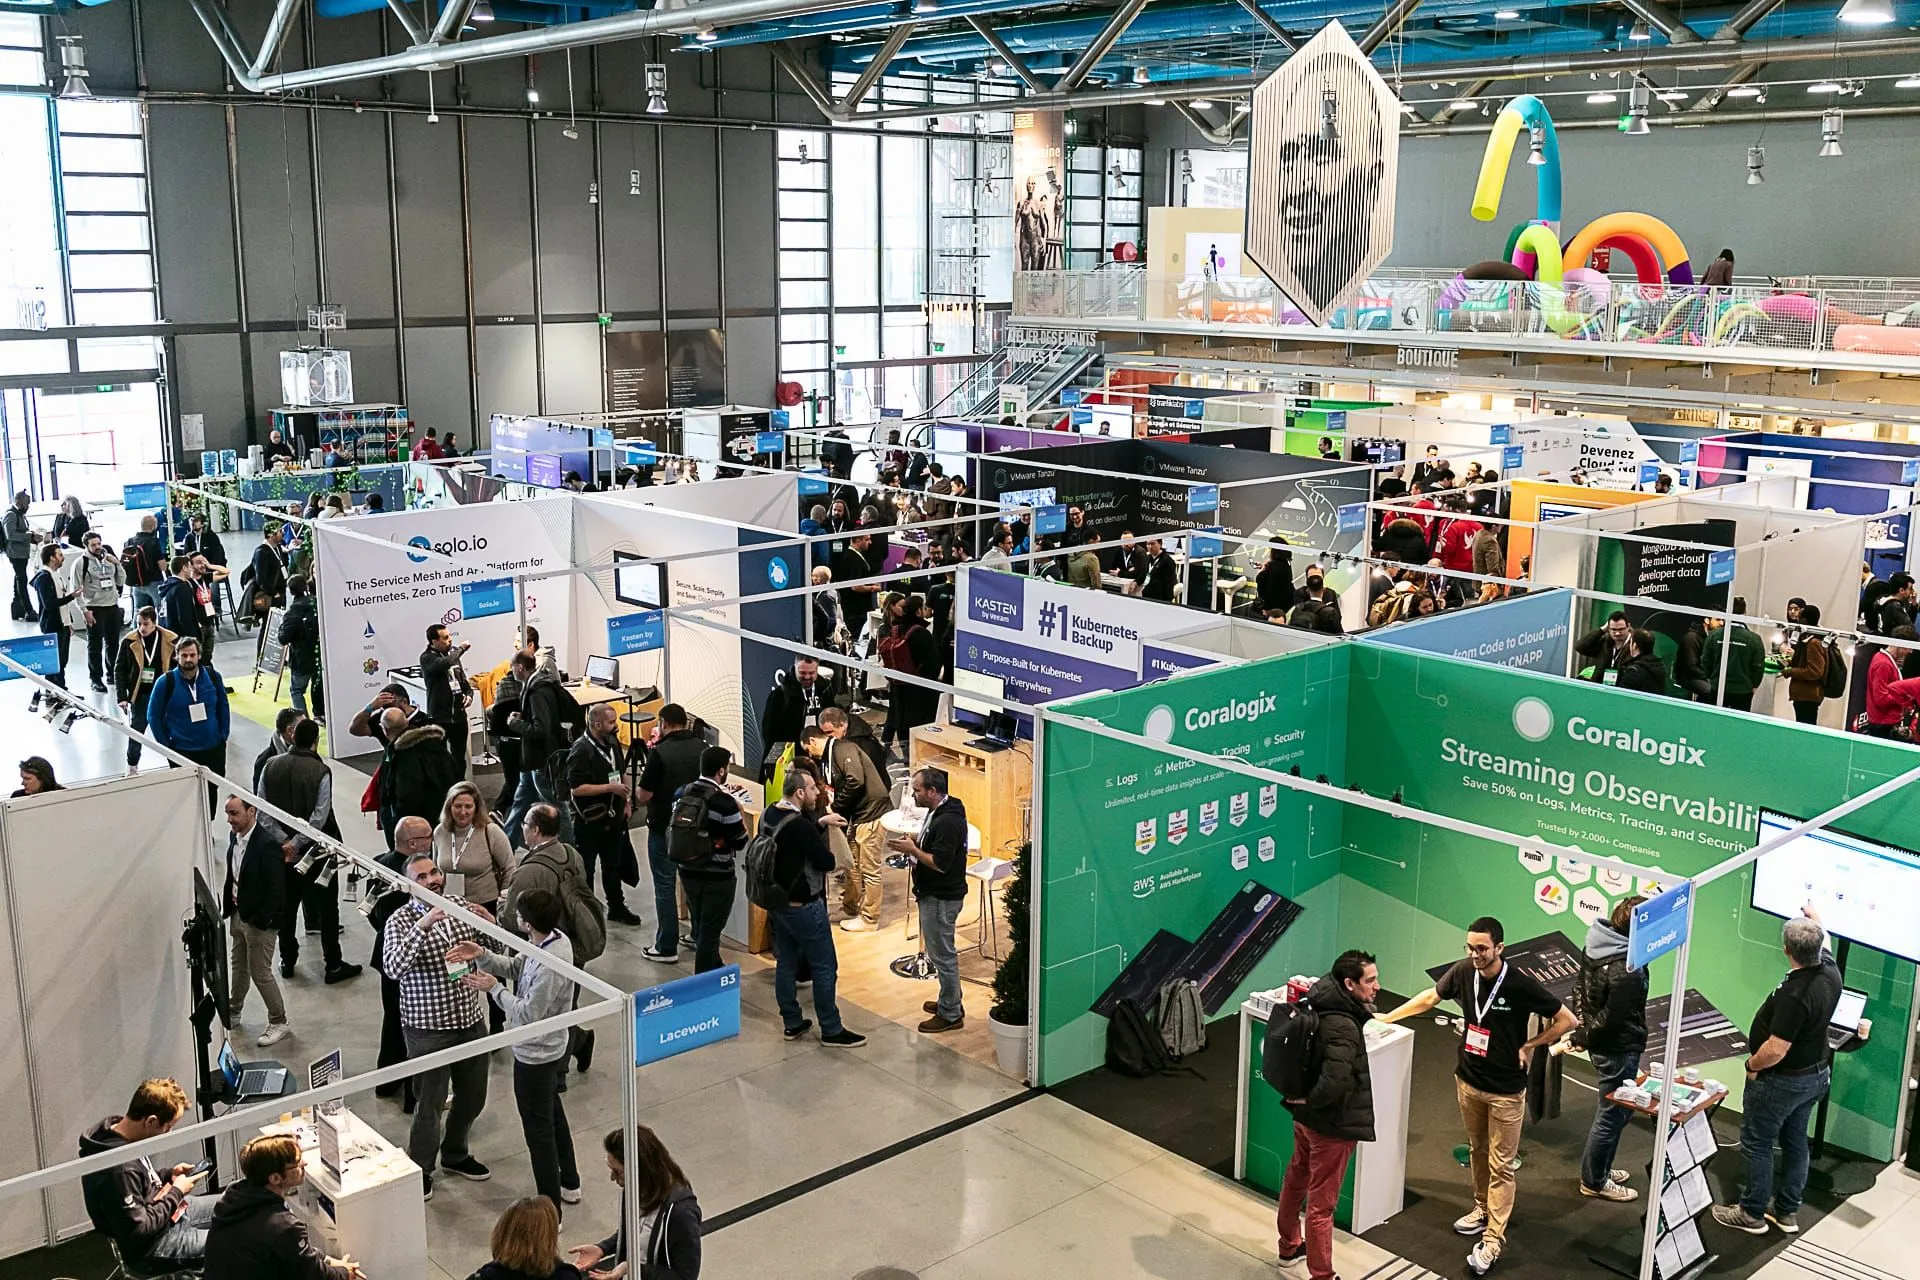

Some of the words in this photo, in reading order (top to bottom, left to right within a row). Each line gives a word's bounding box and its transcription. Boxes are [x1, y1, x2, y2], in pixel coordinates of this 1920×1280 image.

[1007, 327, 1039, 344] ATELIER
[1040, 331, 1057, 346] DES
[1058, 331, 1096, 347] ENFANTS
[1397, 348, 1459, 369] BOUTIQUE
[1580, 444, 1635, 460] Devenez
[1009, 471, 1037, 481] VMware
[1037, 469, 1056, 479] Tanzu
[1159, 463, 1186, 475] VMware
[1186, 466, 1206, 477] Tanzu
[1062, 495, 1074, 503] The
[1074, 493, 1102, 502] smarter
[1141, 488, 1159, 499] Multi
[1160, 490, 1183, 501] Cloud
[1094, 498, 1117, 510] cloud
[1141, 500, 1151, 511] At
[1152, 501, 1172, 513] Scale
[1141, 514, 1156, 524] Your
[1156, 515, 1180, 528] golden
[1180, 519, 1195, 531] path
[433, 535, 488, 554] solo.io
[1640, 558, 1653, 569] The
[1653, 553, 1705, 567] multi-cloud
[346, 580, 368, 592] The
[370, 575, 411, 589] Service
[413, 570, 442, 583] Mesh
[444, 567, 464, 579] and
[530, 556, 544, 567] for
[1638, 569, 1676, 583] developer
[1677, 567, 1701, 578] data
[343, 593, 409, 608] Kubernetes,
[412, 587, 437, 600] Zero
[439, 583, 461, 595] Trus
[706, 587, 725, 598] Simplify
[1637, 583, 1670, 597] platform.
[974, 598, 1017, 616] KASTEN
[981, 611, 989, 621] by
[990, 612, 1010, 623] veeam
[1038, 600, 1069, 642] #1
[1072, 615, 1138, 641] Kubernetes
[621, 634, 643, 644] Kasten
[645, 631, 654, 640] by
[626, 639, 649, 650] Veeam
[1072, 630, 1114, 653] Backup
[1479, 638, 1504, 655] Code
[1506, 637, 1516, 649] to
[1518, 627, 1545, 645] Cloud
[1546, 623, 1567, 639] with
[983, 650, 1026, 672] Purpose-Built
[1028, 660, 1040, 672] for
[1040, 663, 1083, 684] Kubernetes
[1151, 658, 1161, 669] #1
[1508, 649, 1544, 668] CNAPP
[1010, 676, 1052, 695] Everywhere
[1185, 691, 1277, 732] Coralogix
[1566, 716, 1707, 768] Coralogix
[1117, 772, 1138, 787] Logs
[1165, 758, 1196, 773] Metrics
[1221, 743, 1251, 758] Tracing
[1274, 728, 1305, 745] Security
[1440, 737, 1576, 796] Streaming
[1104, 793, 1136, 809] Unlimited,
[1136, 786, 1164, 800] real-time
[1165, 783, 1179, 792] data
[1179, 777, 1201, 792] insights
[1202, 776, 1209, 784] at
[1209, 771, 1225, 781] scale
[1462, 776, 1489, 791] Save
[1491, 782, 1517, 799] 50%
[1519, 789, 1534, 802] on
[1536, 793, 1567, 811] Logs,
[1570, 802, 1616, 824] Metrics,
[1619, 812, 1667, 836] Tracing,
[1671, 826, 1695, 841] and
[1698, 832, 1751, 854] Security
[1536, 819, 1566, 834] Trusted
[1568, 827, 1580, 839] by
[1612, 838, 1661, 859] Companies
[1133, 876, 1155, 892] aws
[1159, 880, 1171, 890] AWS
[1171, 872, 1202, 886] Marketplace
[1160, 869, 1183, 881] Available
[1639, 911, 1649, 923] C5
[1647, 930, 1678, 953] Coralogix
[720, 973, 736, 987] B3
[660, 1016, 720, 1044] Lacework
